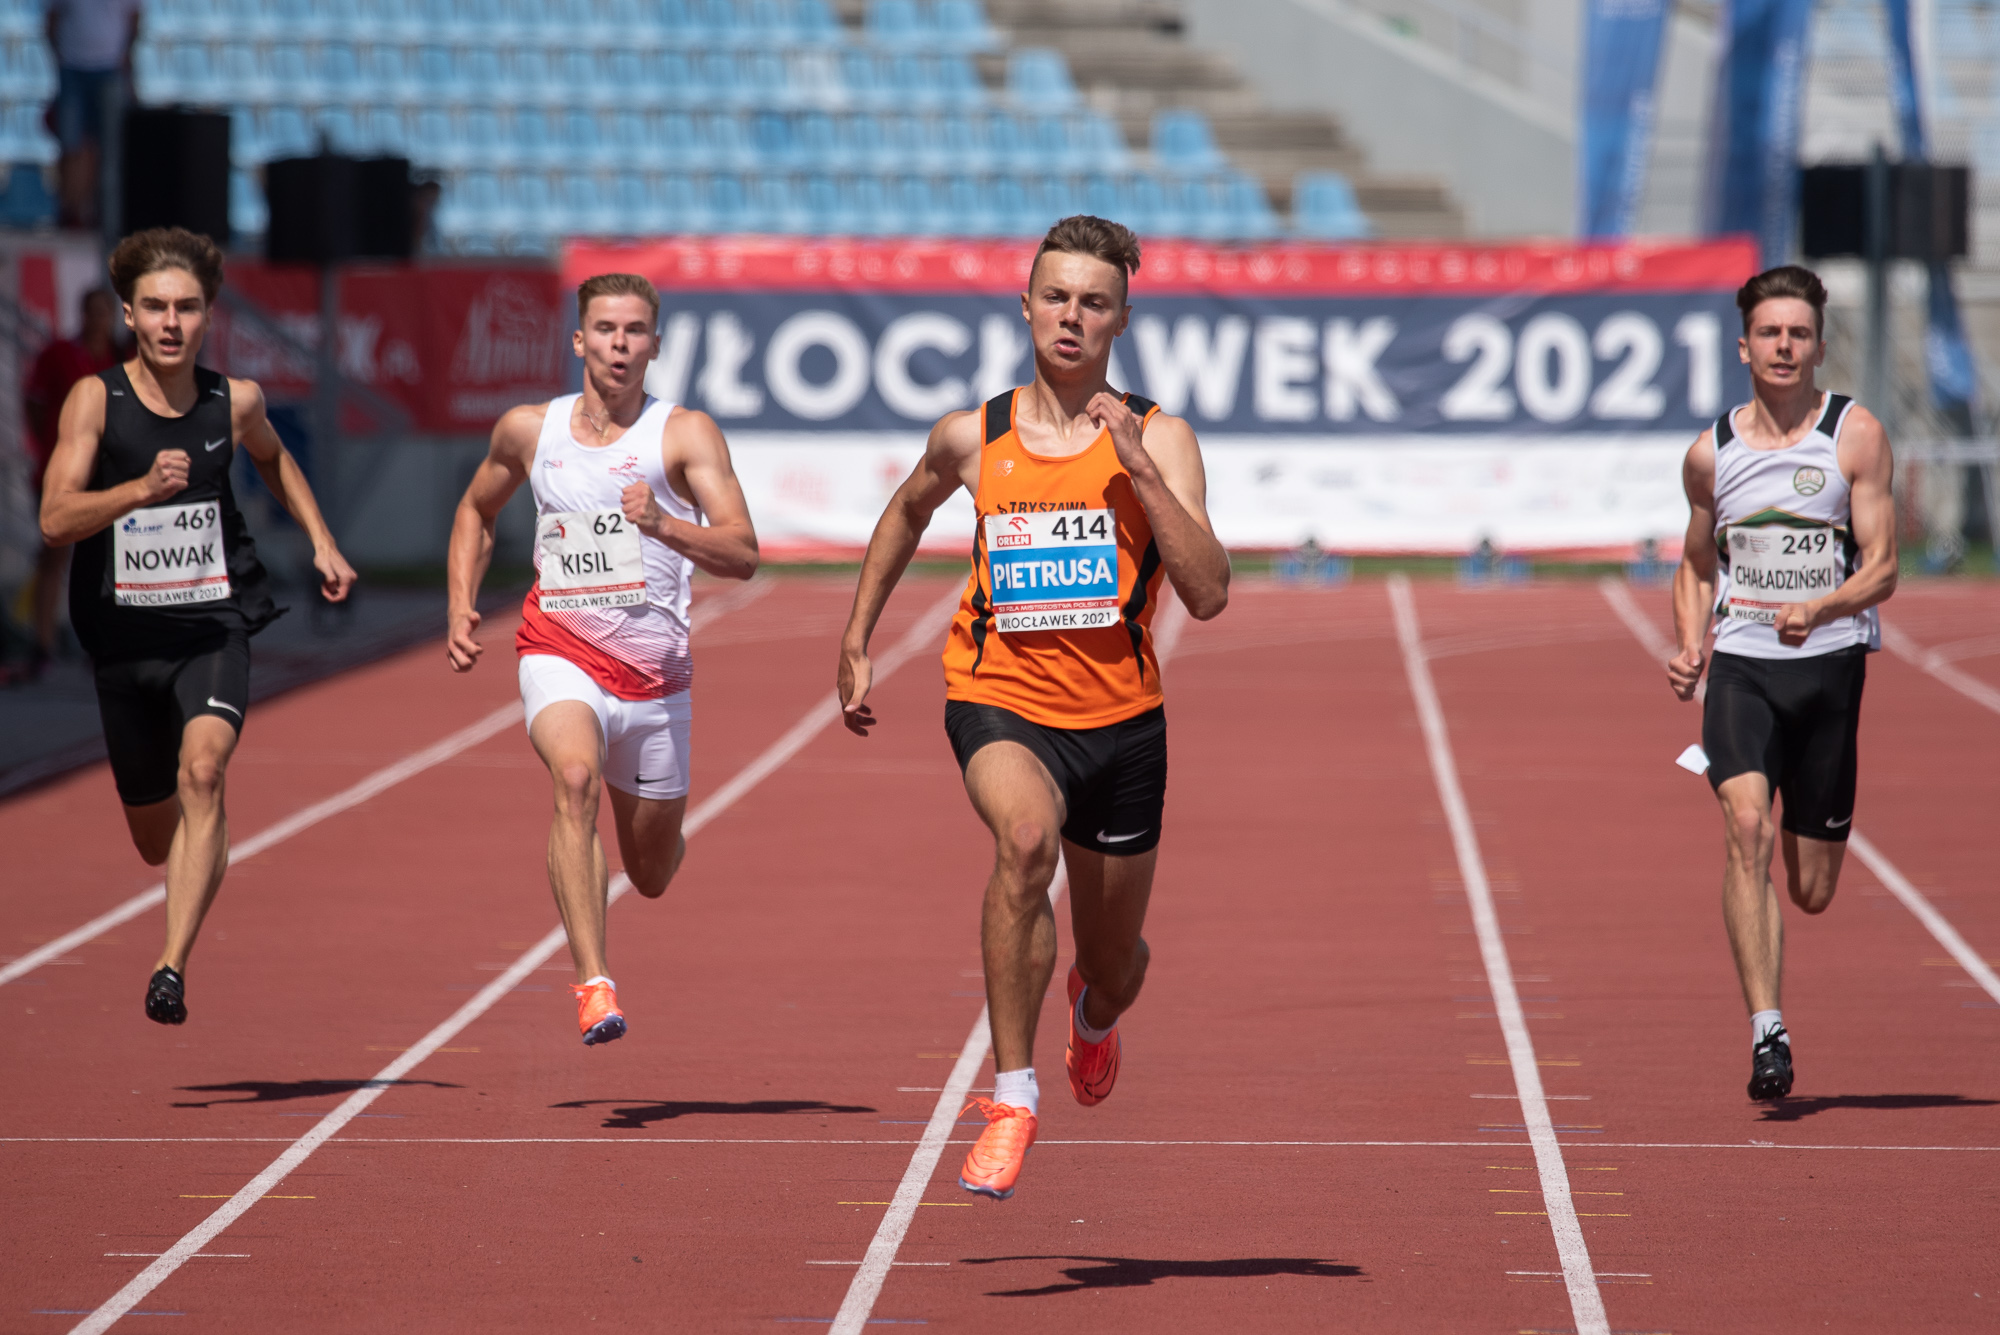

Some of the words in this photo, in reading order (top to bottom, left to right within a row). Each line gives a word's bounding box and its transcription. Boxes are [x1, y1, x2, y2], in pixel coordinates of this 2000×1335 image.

[1438, 311, 1723, 422] 2021
[174, 507, 216, 531] 469
[593, 513, 623, 535] 62
[1051, 515, 1107, 541] 414
[998, 536, 1030, 546] ORLEN
[1782, 533, 1827, 554] 249
[125, 542, 215, 571] NOWAK
[561, 552, 613, 576] KISIL
[993, 558, 1113, 589] PIETRUSA
[1736, 565, 1831, 590] CHAŁADZIŃSKI
[200, 586, 223, 599] 2021
[546, 595, 611, 610] WŁOCŁAWEK
[615, 593, 640, 604] 2021
[1020, 603, 1072, 611] MISTRZOSTWA
[1001, 614, 1077, 629] WŁOCŁAWEK
[1082, 612, 1111, 625] 2021
